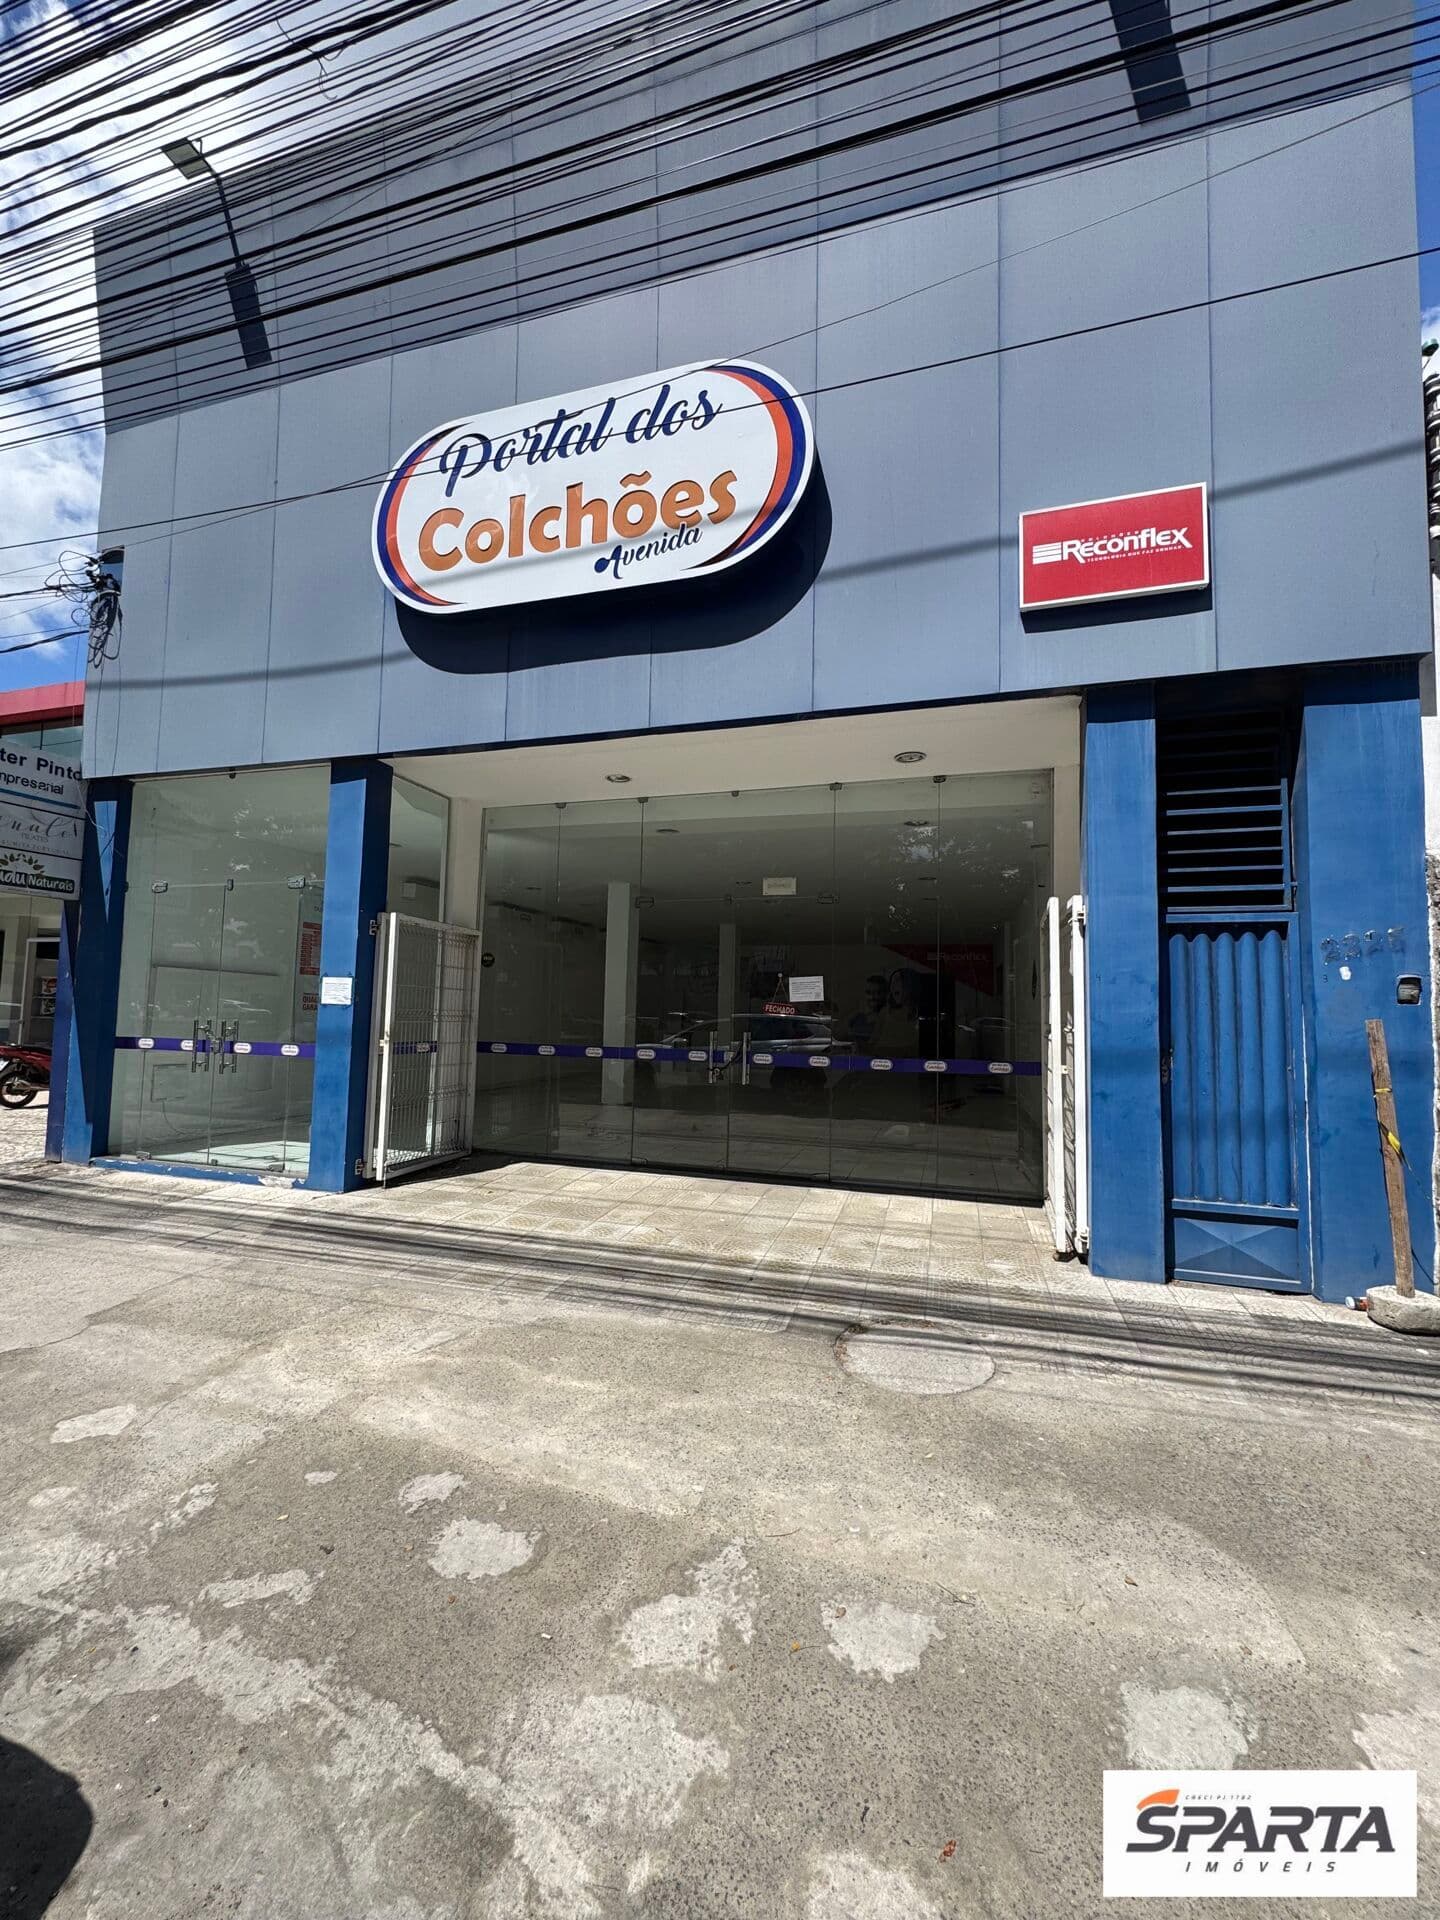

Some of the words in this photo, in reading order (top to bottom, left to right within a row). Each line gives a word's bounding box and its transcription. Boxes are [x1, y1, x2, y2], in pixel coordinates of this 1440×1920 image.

[439, 397, 614, 497] Portal
[625, 384, 723, 445] dos
[418, 469, 738, 572] Colchões
[594, 523, 704, 580] Avenida
[28, 874, 74, 892] Naturais
[764, 1004, 796, 1015] FECHADO
